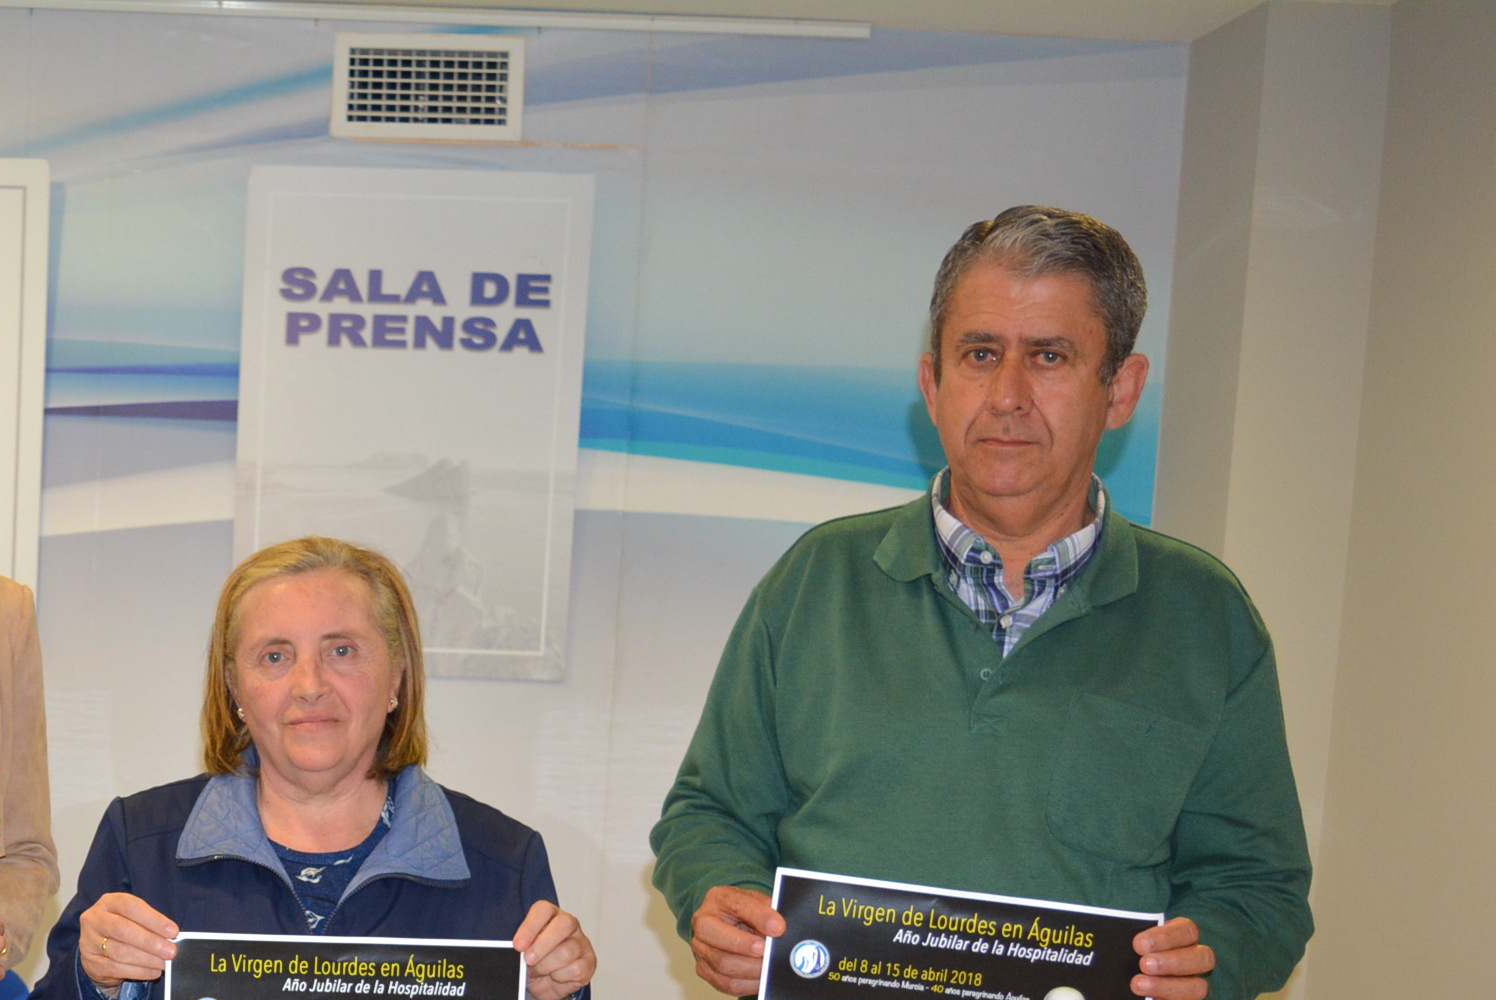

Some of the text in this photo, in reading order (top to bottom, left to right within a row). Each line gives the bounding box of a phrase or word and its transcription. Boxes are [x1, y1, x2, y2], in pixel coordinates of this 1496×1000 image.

[279, 266, 552, 309] SALA DE
[285, 312, 544, 353] PRENSA
[818, 895, 1092, 950] La Virgen de Lourdes en Águilas
[892, 928, 1092, 965] Año Jubilar de la Hospitalidad
[210, 953, 464, 983] La Virgen de Lourdes en Águilas
[838, 957, 982, 986] del 8 al 15 de abril 2018
[282, 977, 466, 999] Año Jubilar de la Hospitalidad
[828, 972, 840, 980] 50
[857, 977, 900, 987] peregrinando
[930, 984, 943, 993] 40
[961, 989, 1004, 1000] peregrinando
